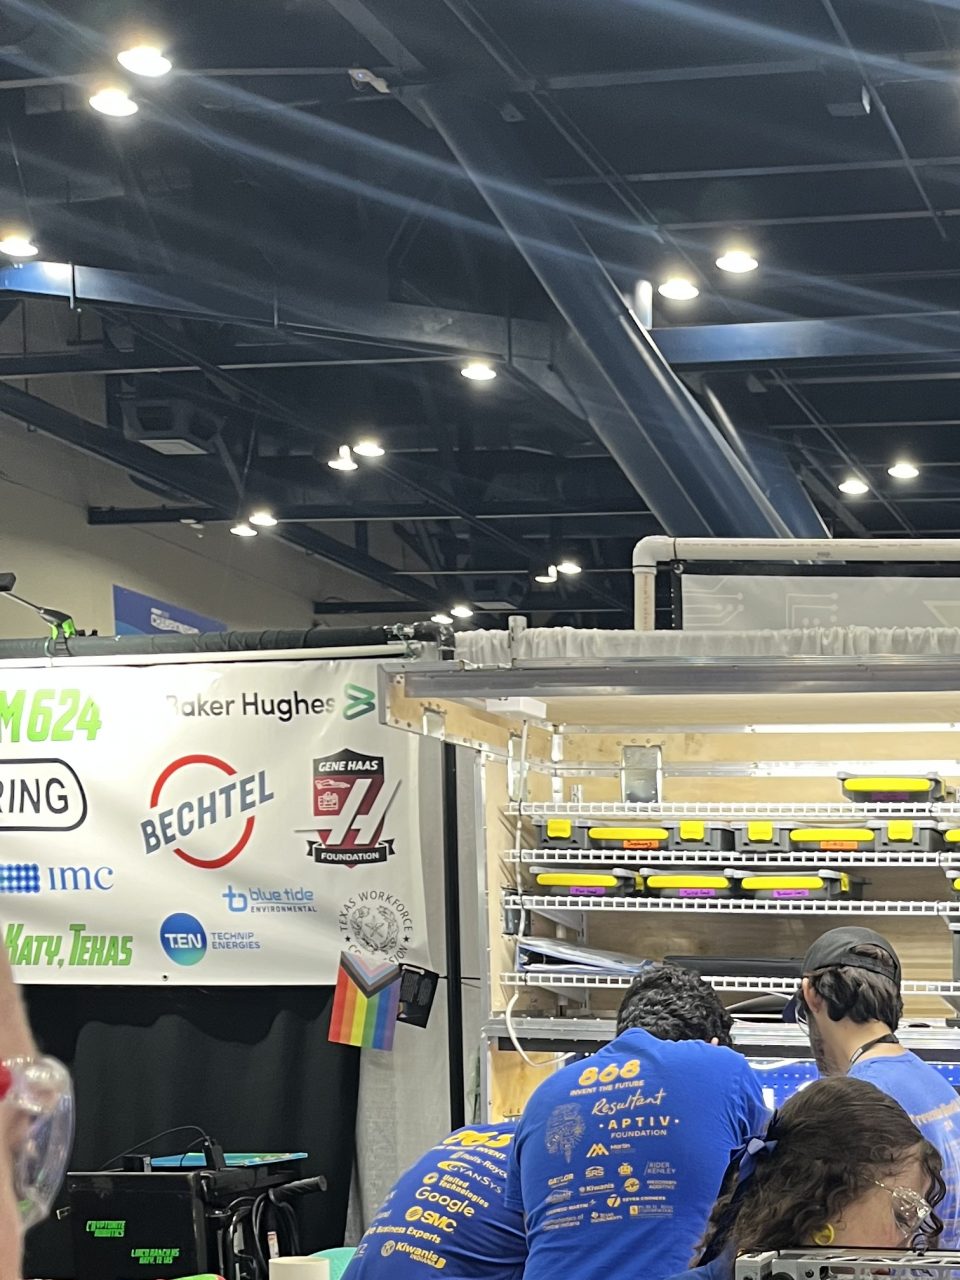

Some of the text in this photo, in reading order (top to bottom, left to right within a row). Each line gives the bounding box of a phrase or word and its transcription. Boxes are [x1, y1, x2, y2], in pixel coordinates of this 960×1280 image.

[242, 691, 336, 722] Hughes
[319, 761, 379, 771] GENE HAAS
[0, 777, 69, 814] ING
[141, 770, 274, 854] BECHTEL
[321, 852, 379, 861] FOUNDATION
[48, 864, 114, 891] imc
[249, 887, 314, 901] blue tide
[251, 905, 317, 913] ENVIRONMENTAL
[339, 890, 413, 932] TEXAS WORKFORCE
[211, 932, 254, 940] TECHNIP
[212, 941, 260, 949] ENERGIES
[578, 1060, 640, 1086] 868
[570, 1080, 645, 1096] INVENT THE FUTURE
[592, 1087, 667, 1116] Resultant
[608, 1116, 670, 1130] APTIV
[611, 1130, 667, 1138] FOUNDATION
[442, 1174, 470, 1188] United
[586, 1183, 615, 1192] Kiwanis
[415, 1186, 475, 1217] Google
[438, 1180, 490, 1208] Technologies
[421, 1210, 457, 1233] SMC
[407, 1226, 441, 1244] Experts
[395, 1242, 439, 1263] Kiwanis
